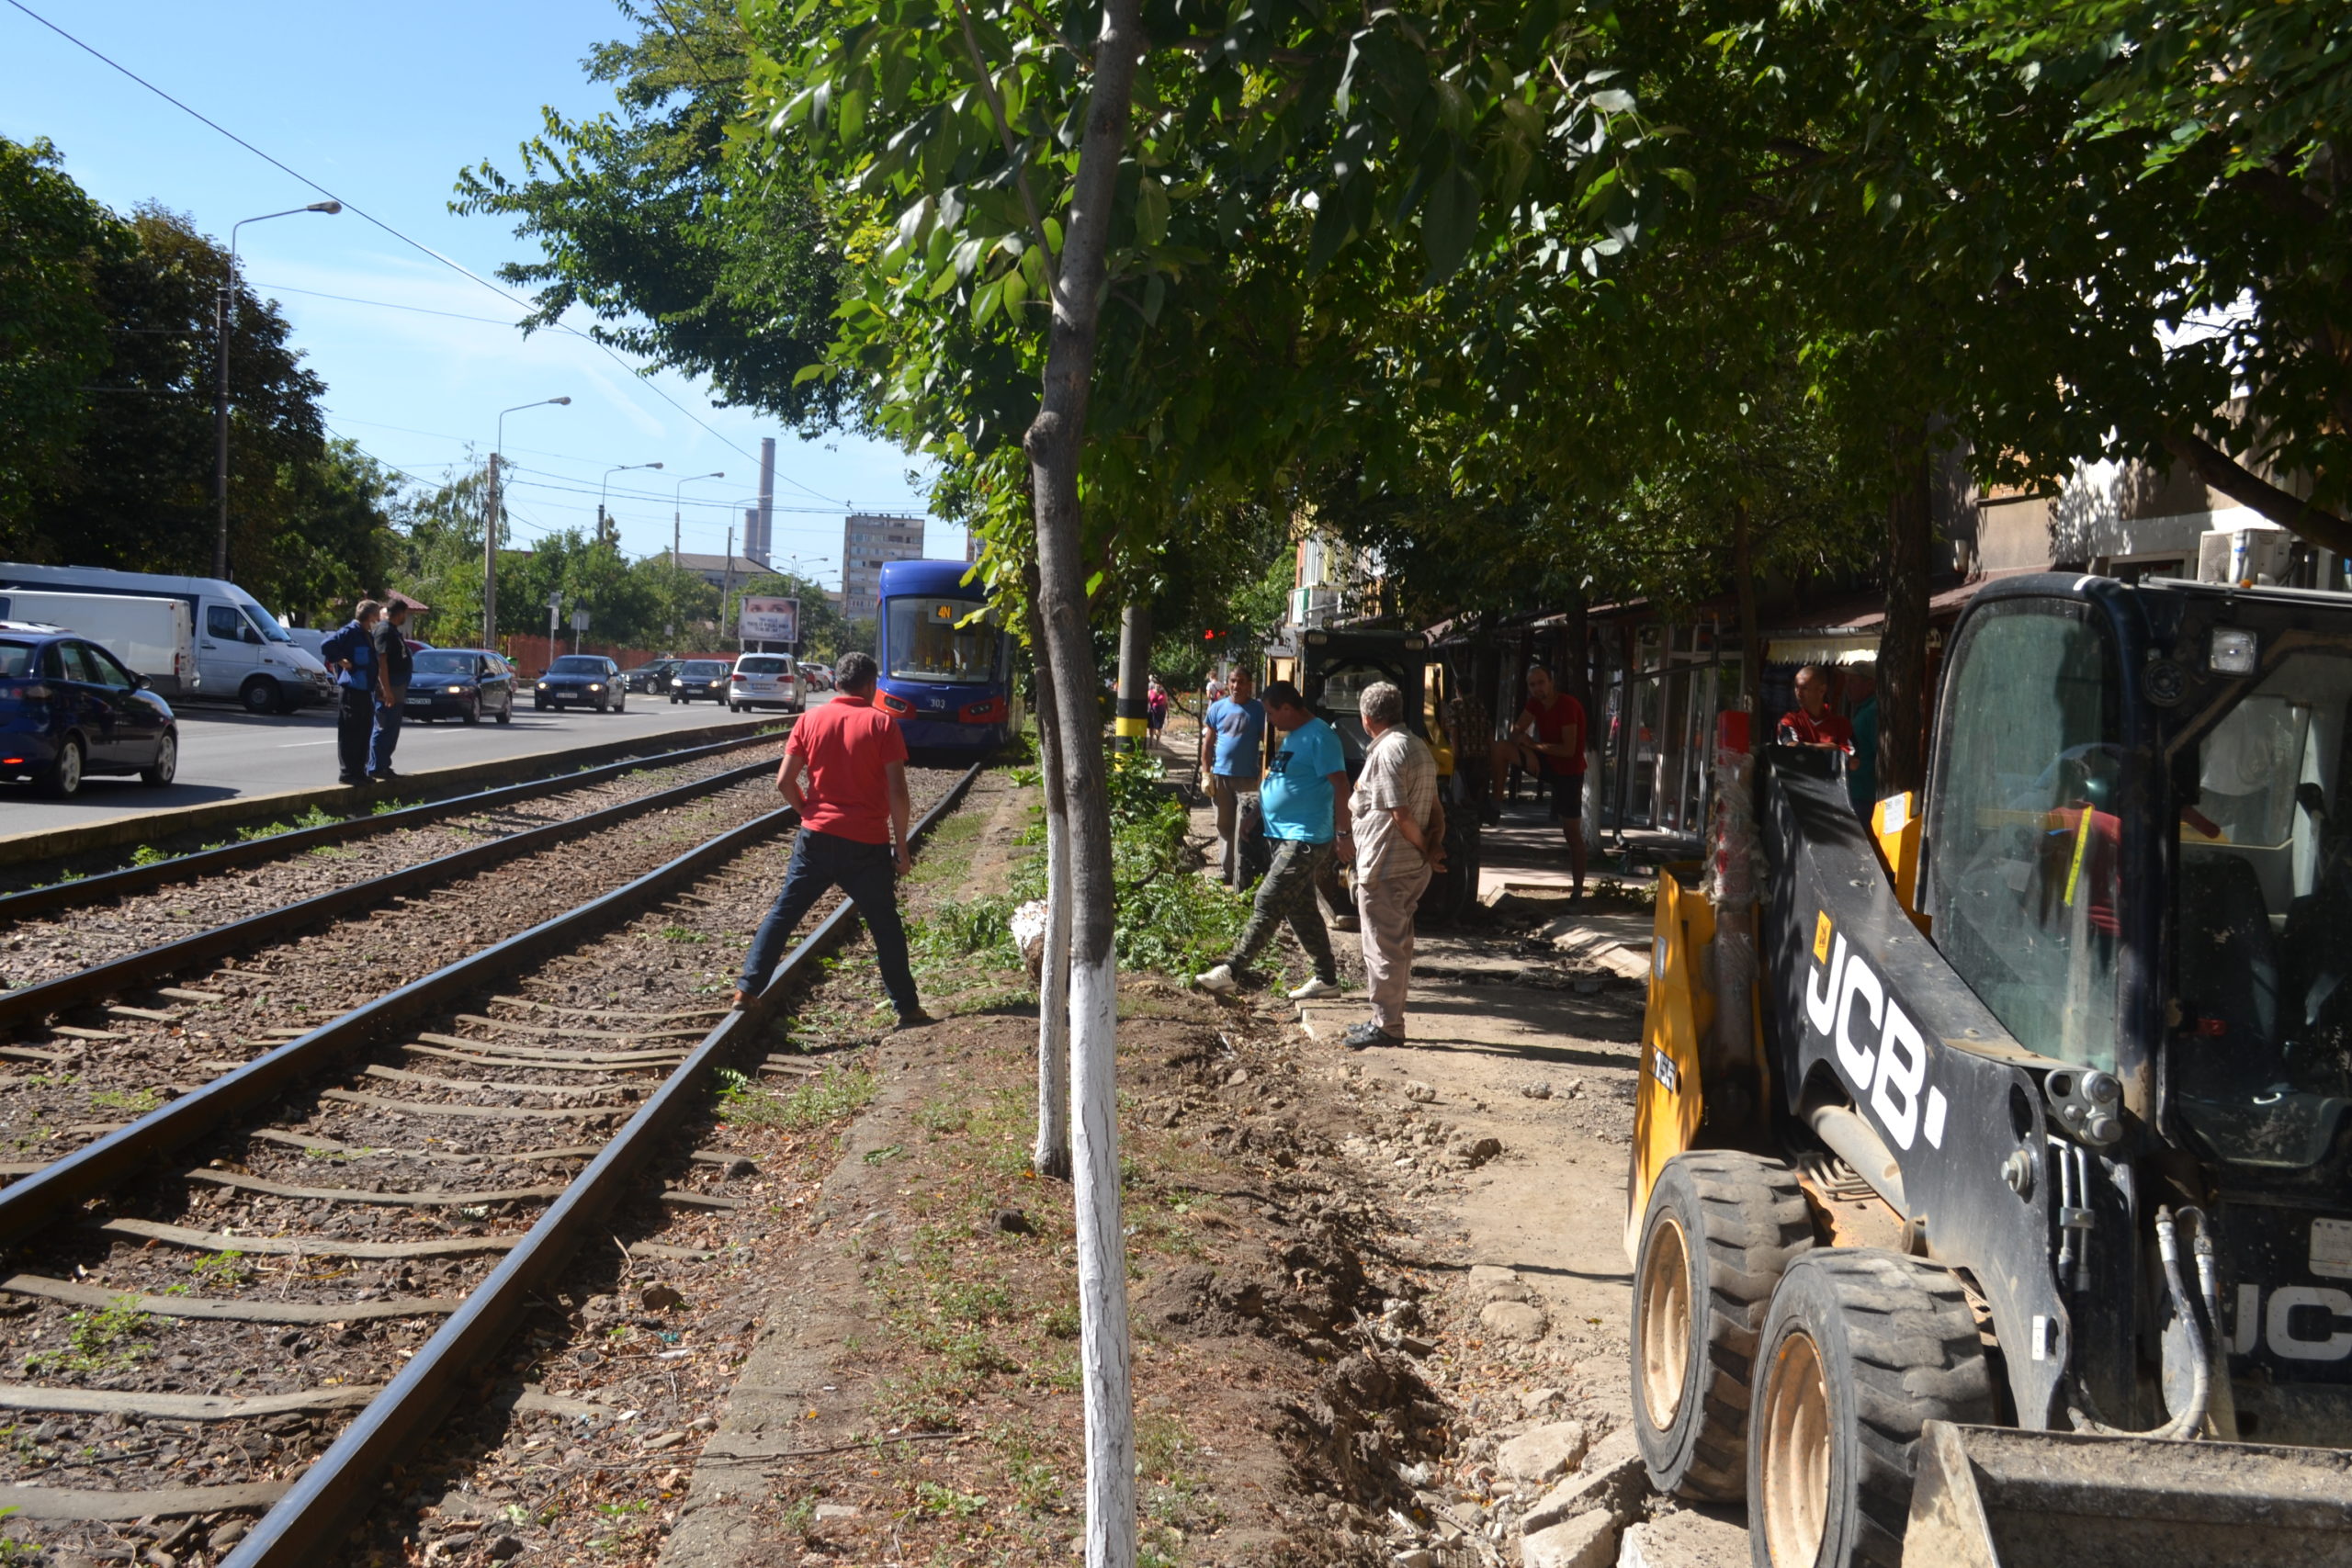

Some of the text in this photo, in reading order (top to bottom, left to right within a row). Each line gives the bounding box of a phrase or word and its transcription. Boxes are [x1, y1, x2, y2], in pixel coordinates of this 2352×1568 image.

[938, 605, 951, 618] 4N
[930, 698, 945, 708] 303
[1806, 931, 1927, 1151] JCB
